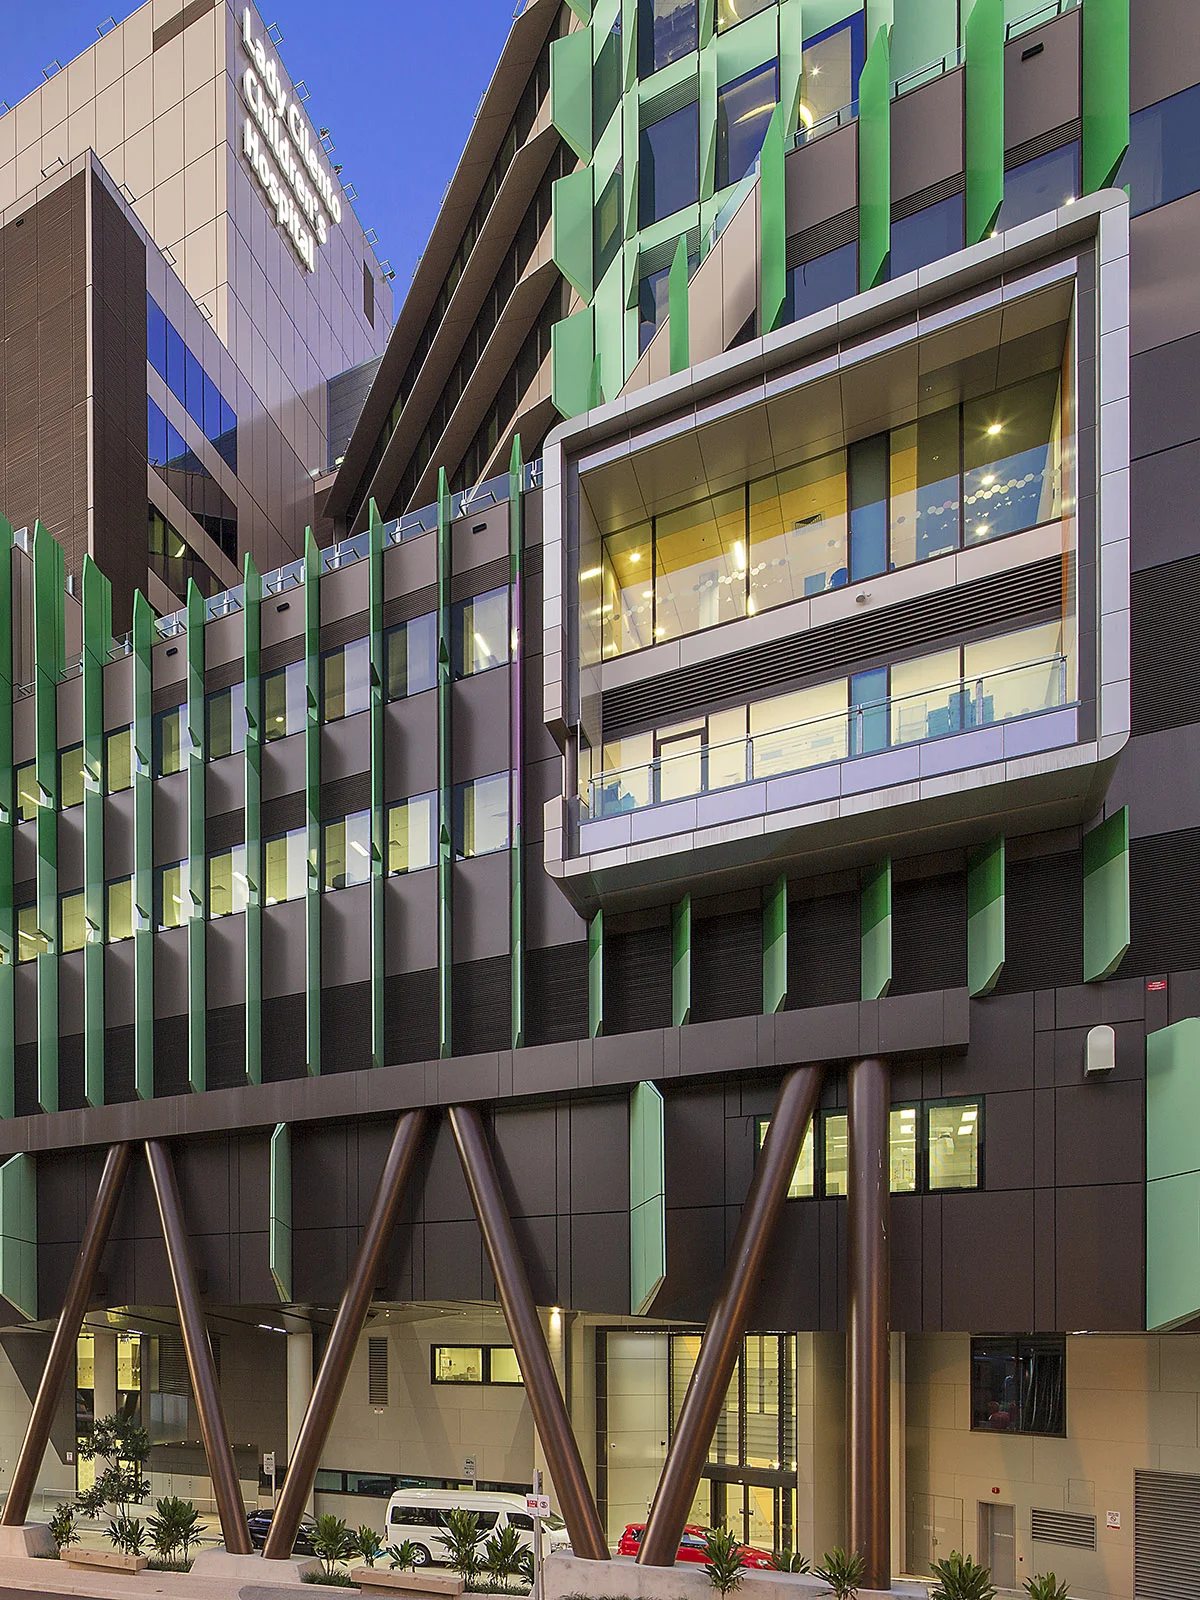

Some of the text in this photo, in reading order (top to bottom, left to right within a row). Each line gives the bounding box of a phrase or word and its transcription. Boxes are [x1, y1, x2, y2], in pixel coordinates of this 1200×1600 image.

[243, 7, 341, 225] Lady Cilento
[243, 67, 327, 246] Children's
[243, 118, 315, 274] Hospital
